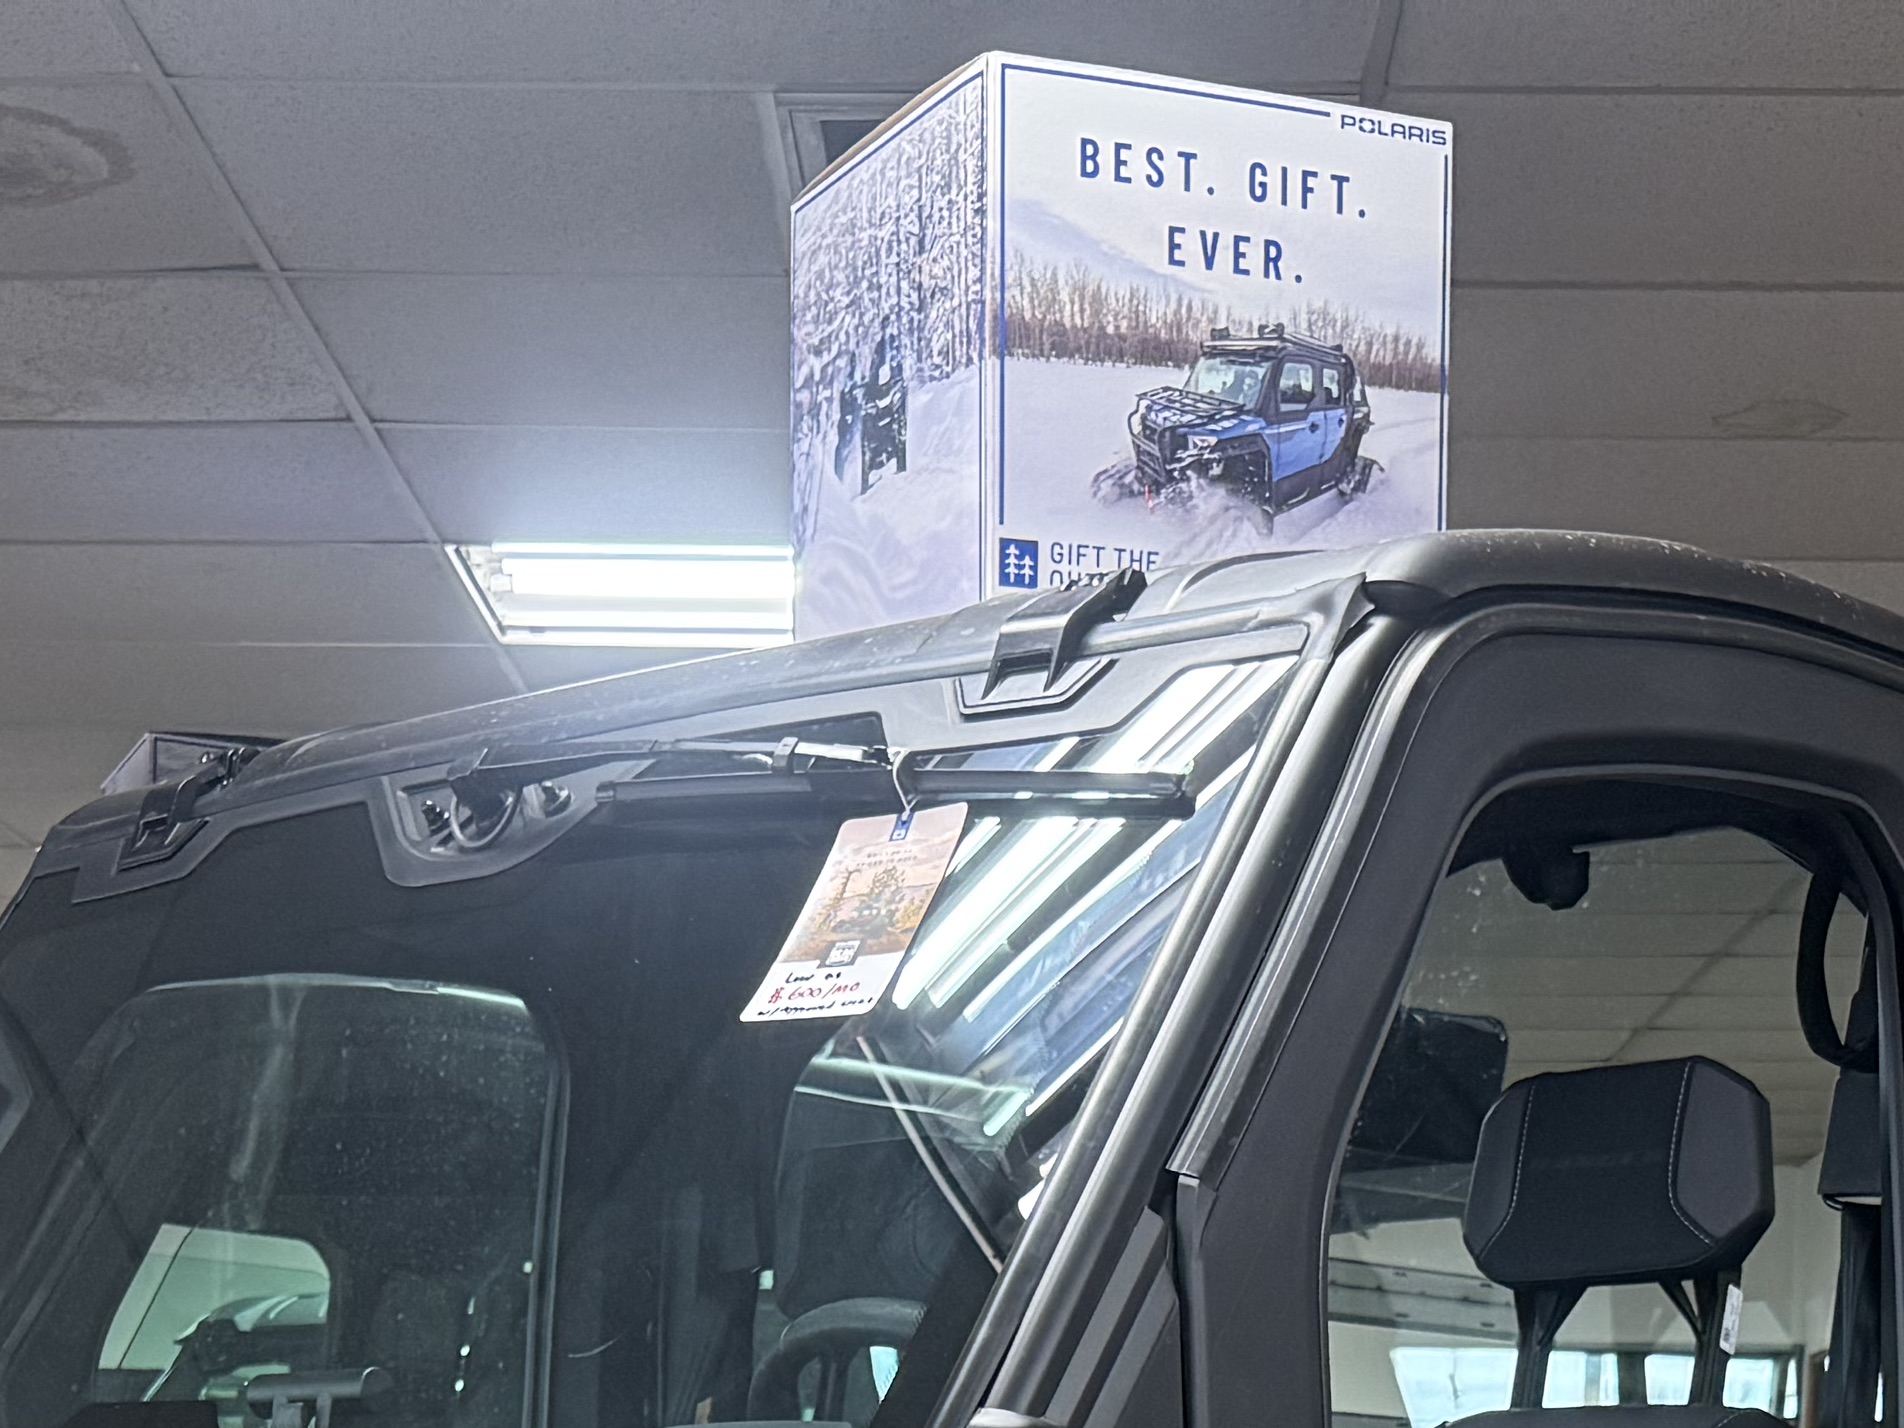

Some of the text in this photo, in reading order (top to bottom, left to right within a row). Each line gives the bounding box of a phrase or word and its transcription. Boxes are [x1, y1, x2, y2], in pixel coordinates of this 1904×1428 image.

[1340, 113, 1448, 147] POLARIS
[1078, 137, 1369, 218] BEST. GIFT.
[1167, 225, 1304, 285] EVER.
[1049, 541, 1104, 570] GIFT
